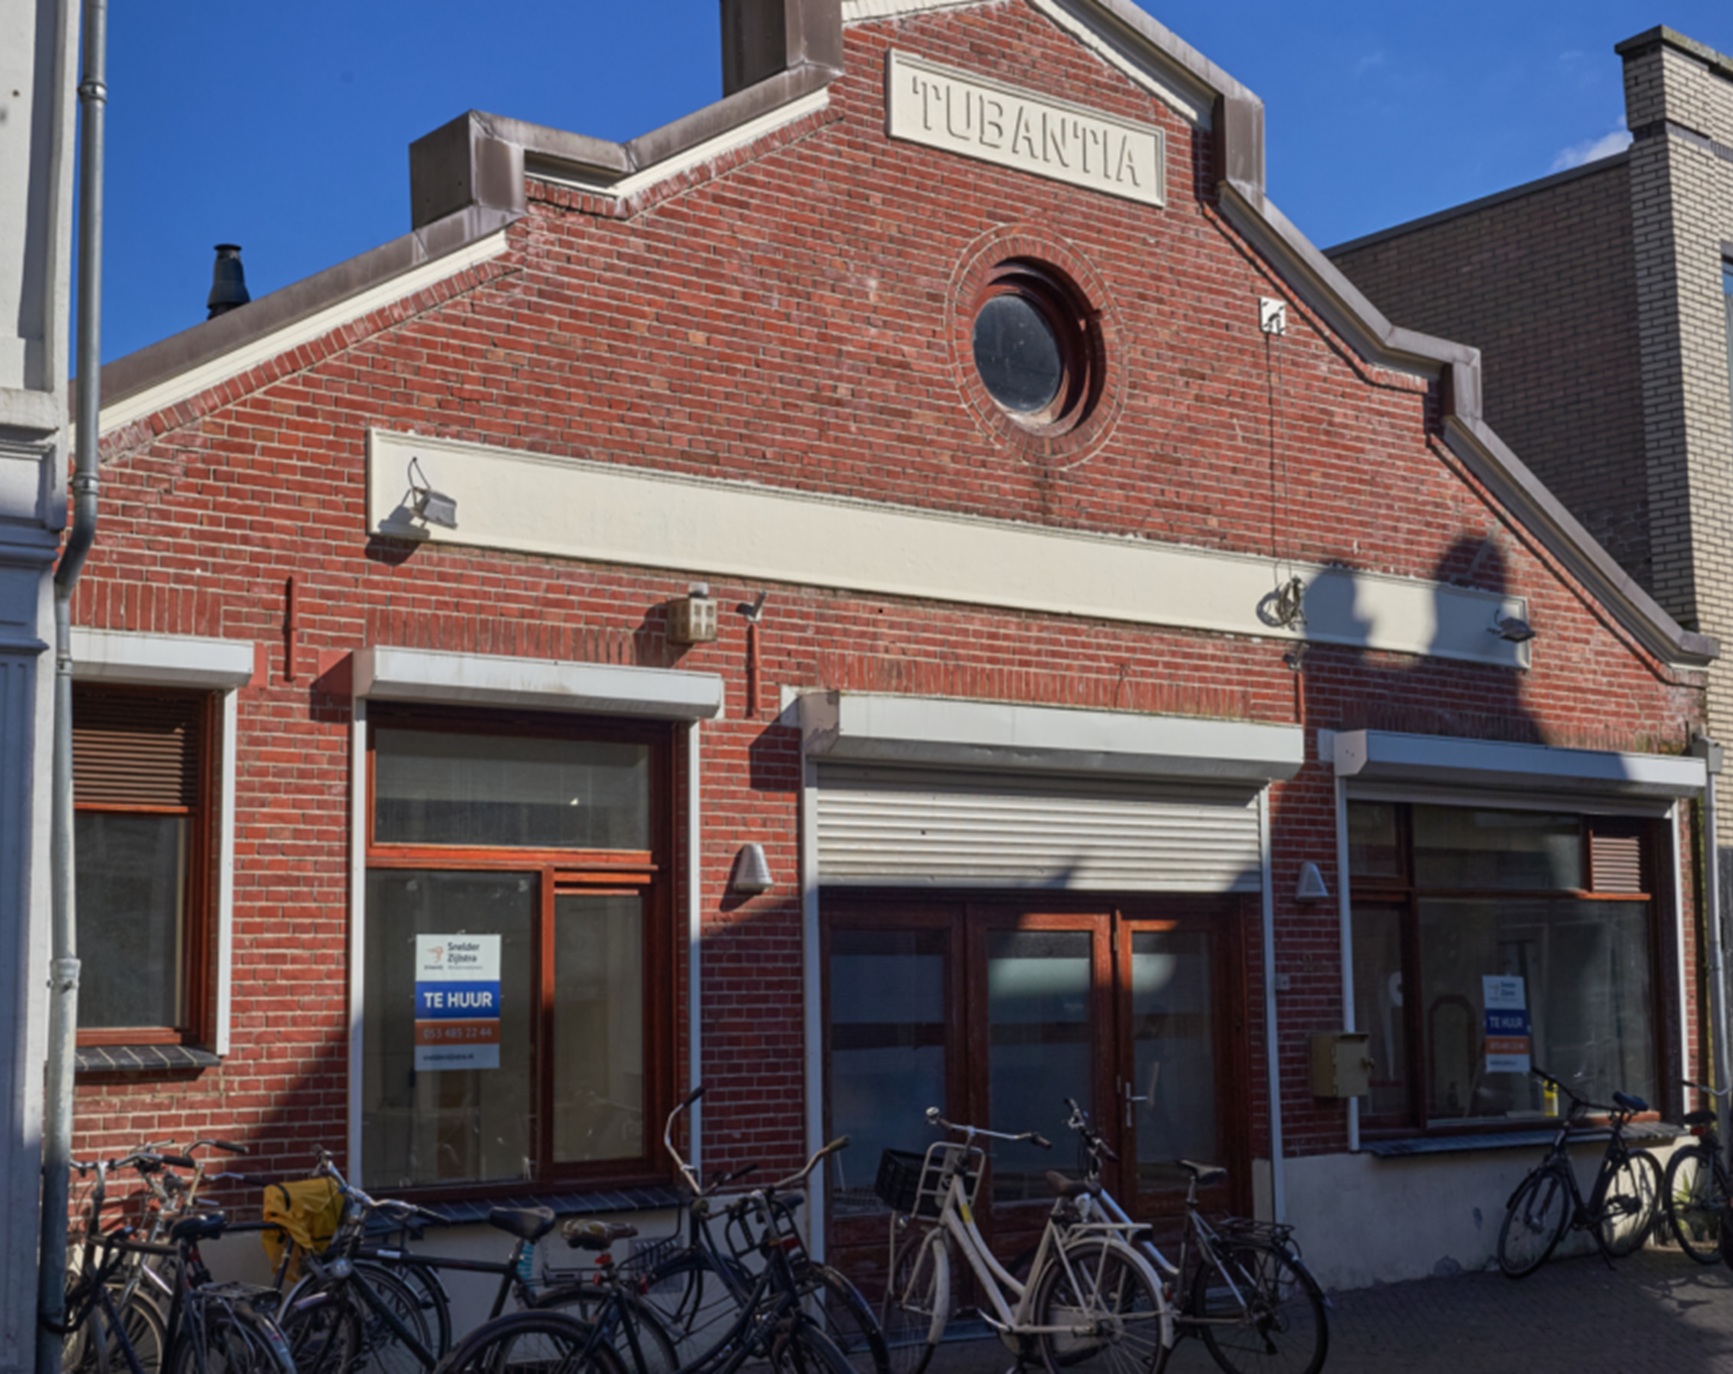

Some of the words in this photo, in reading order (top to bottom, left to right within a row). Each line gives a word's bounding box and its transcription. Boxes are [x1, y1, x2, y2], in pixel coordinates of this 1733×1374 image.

[911, 75, 1141, 188] TUBANTIA
[423, 992, 444, 1008] TE
[447, 992, 493, 1008] HUUR
[1502, 1017, 1523, 1029] HUUR
